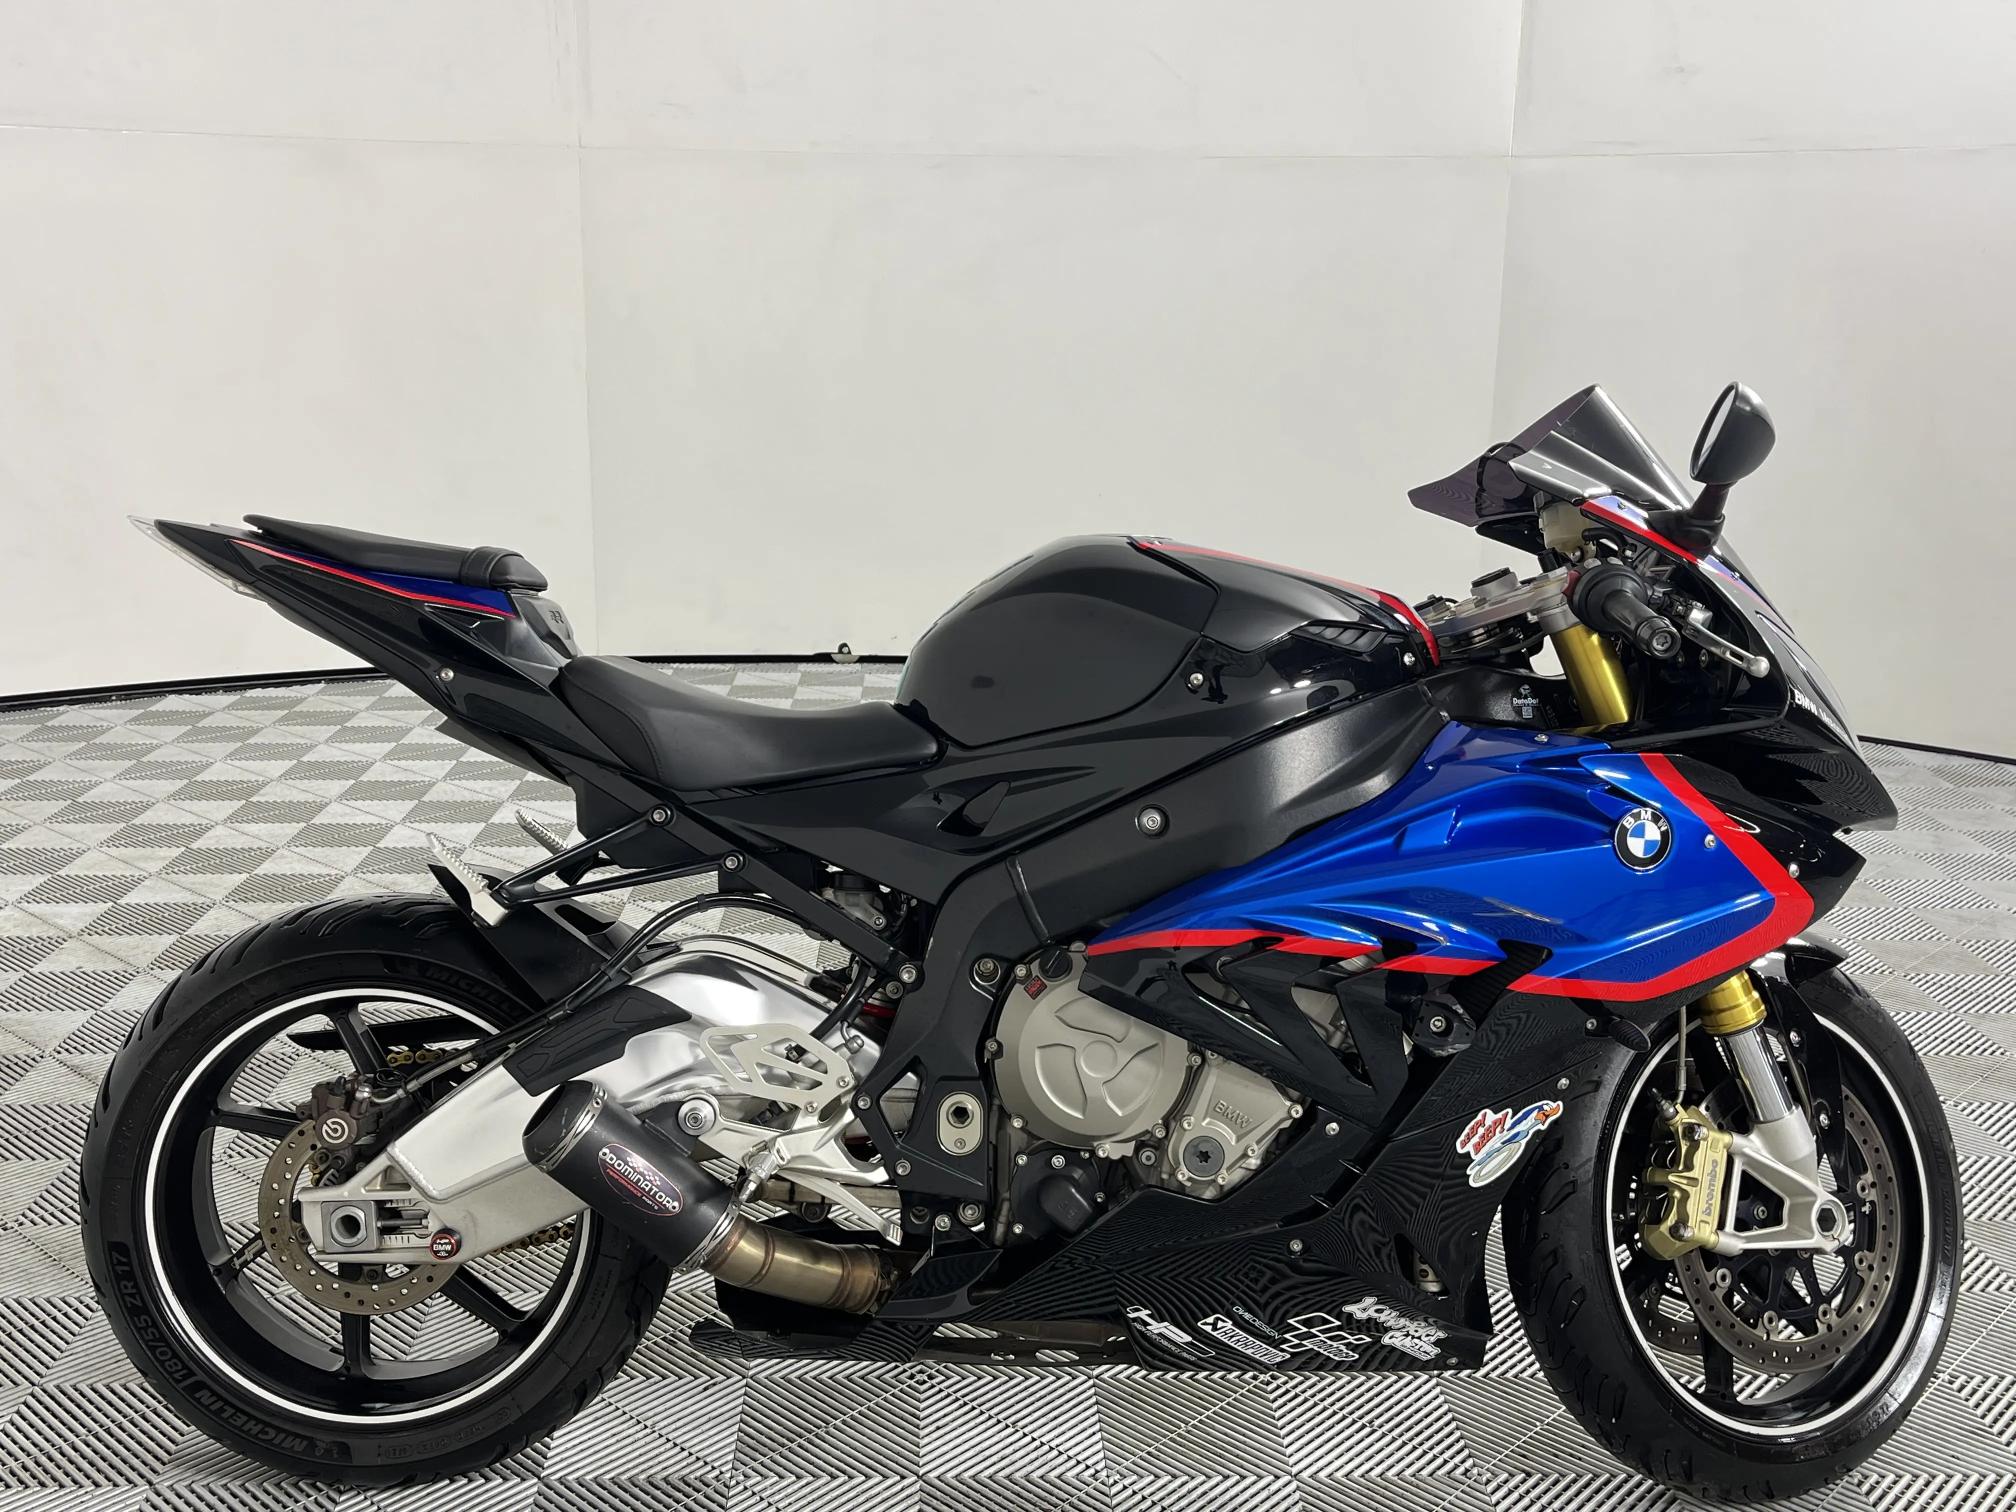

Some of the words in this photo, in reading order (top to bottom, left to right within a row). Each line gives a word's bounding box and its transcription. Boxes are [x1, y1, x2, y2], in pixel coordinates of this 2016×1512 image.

[1622, 809, 1668, 832] BMW
[1214, 1100, 1252, 1128] BMW
[1460, 1111, 1488, 1150] BEEP!
[1472, 1110, 1510, 1156] BEEP!
[606, 1151, 673, 1209] DOMINATOR
[1702, 1158, 1719, 1217] brembo
[110, 1249, 130, 1275] 17
[118, 1278, 143, 1310] ZR
[133, 1311, 190, 1382] 180/55
[192, 1385, 308, 1453] MICHELIN
